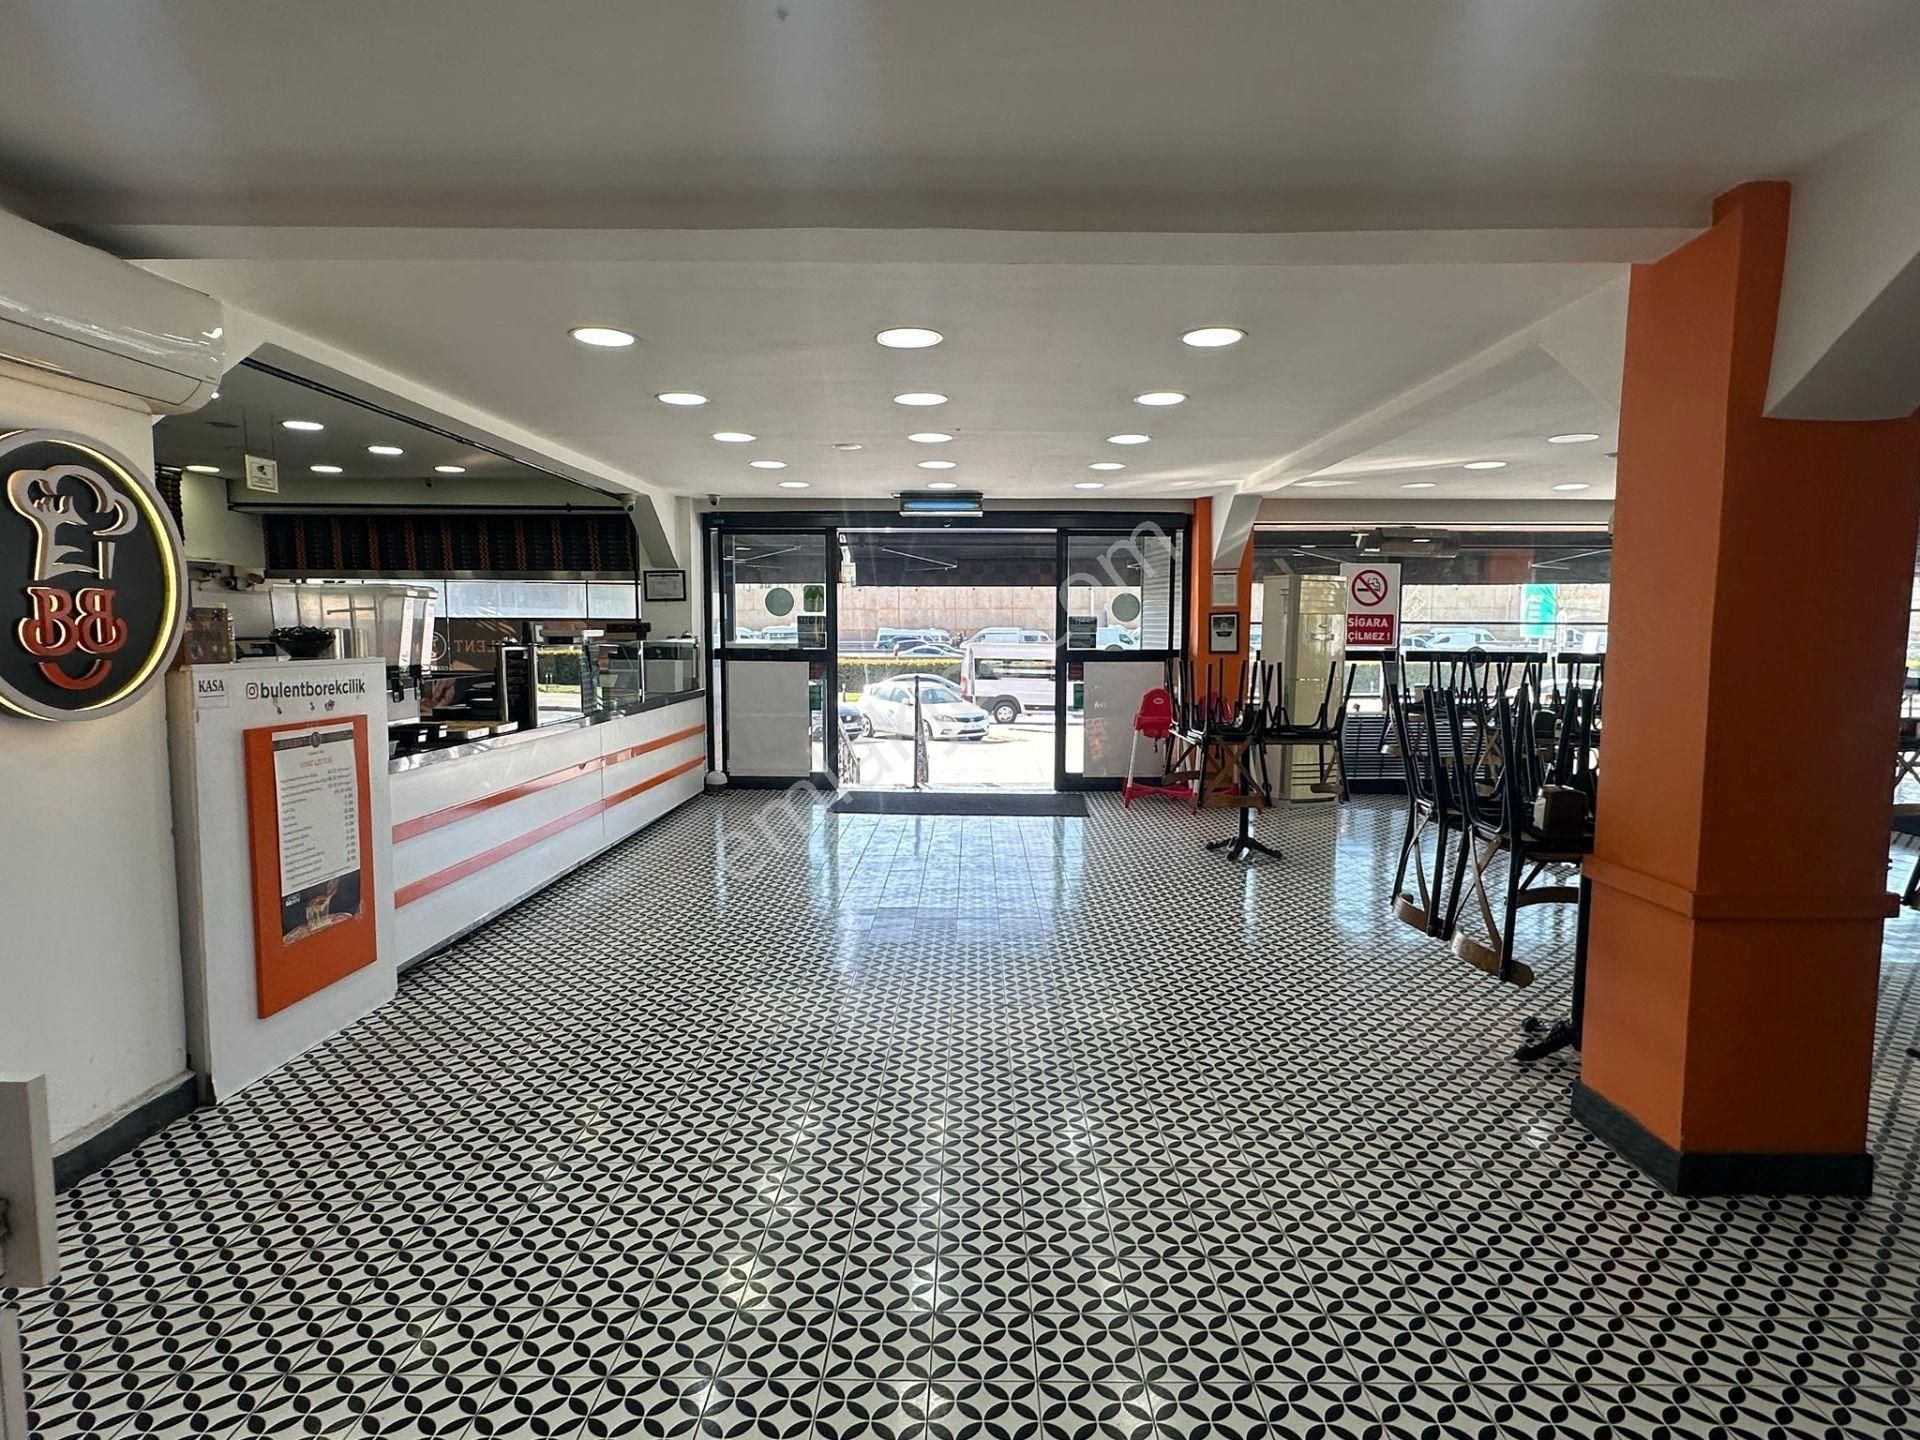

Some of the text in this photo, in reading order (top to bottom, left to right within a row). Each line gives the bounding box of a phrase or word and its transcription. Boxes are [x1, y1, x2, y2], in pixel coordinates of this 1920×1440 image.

[1347, 615, 1389, 627] SİGARA
[1347, 630, 1385, 642] ÇİLMEZ
[198, 679, 225, 692] KASA
[260, 678, 366, 699] bulentborekcilik
